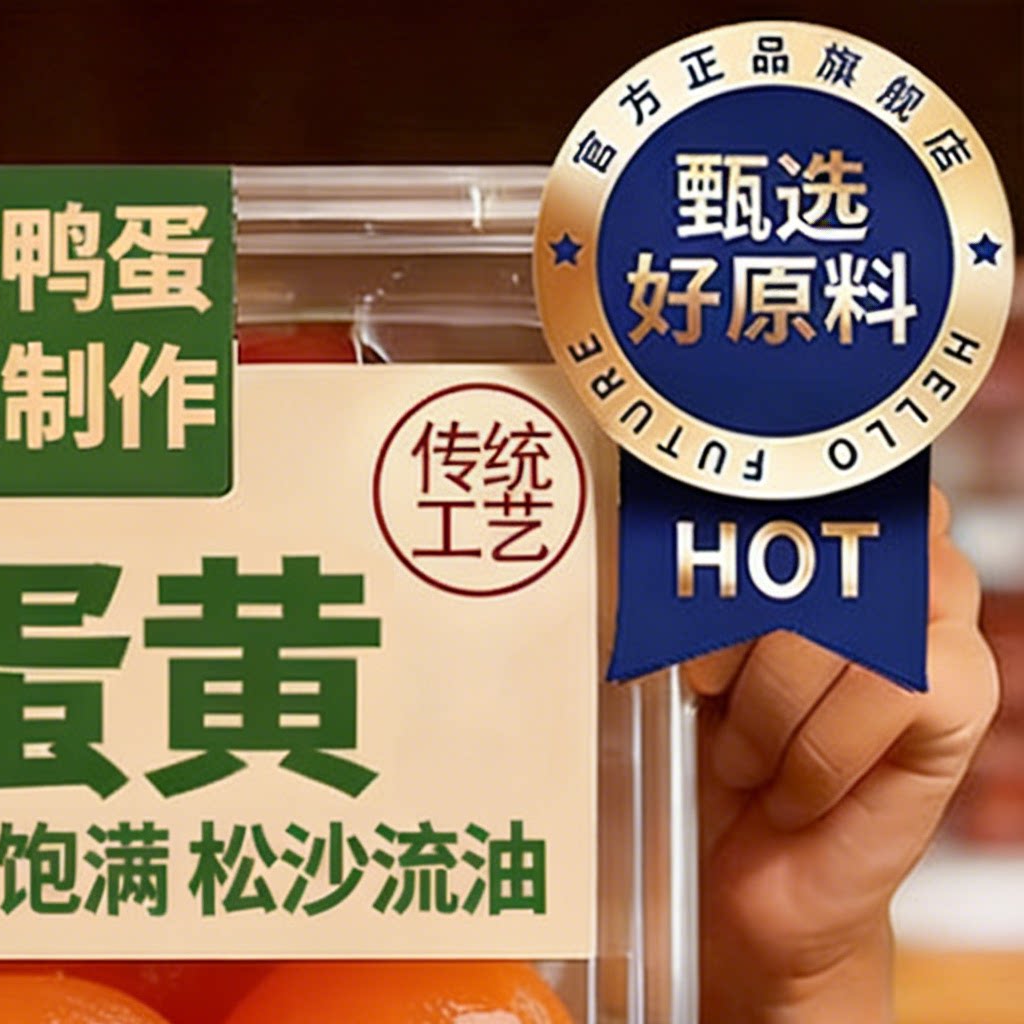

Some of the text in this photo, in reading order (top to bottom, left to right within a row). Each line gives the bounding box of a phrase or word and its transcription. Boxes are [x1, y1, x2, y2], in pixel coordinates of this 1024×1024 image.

[412, 420, 553, 494] 传统
[412, 492, 553, 562] 工艺
[188, 822, 548, 917] 松沙流油
